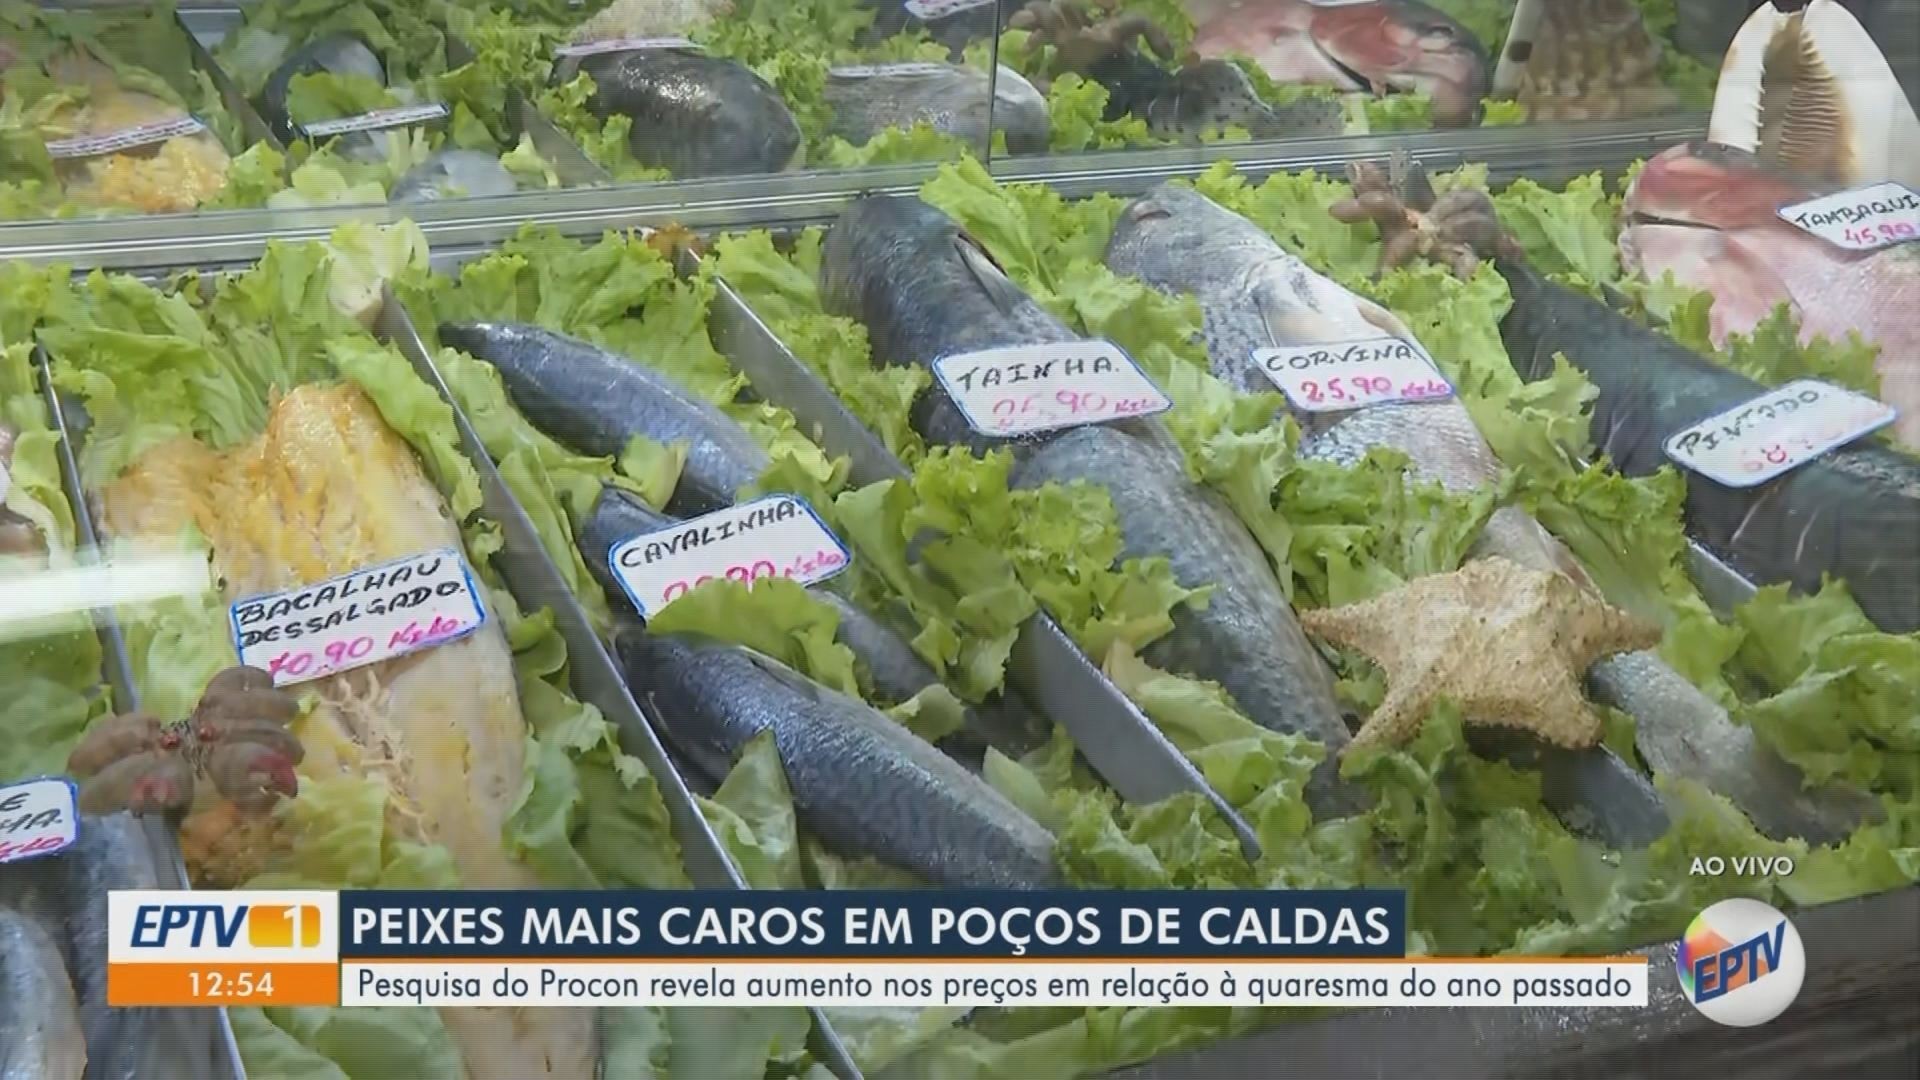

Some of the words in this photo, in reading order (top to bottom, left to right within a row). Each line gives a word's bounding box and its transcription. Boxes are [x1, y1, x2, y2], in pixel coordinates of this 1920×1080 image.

[1795, 195, 1920, 228] TAMBAQUI
[1300, 377, 1393, 403] 25,90
[237, 557, 441, 625] BACALHAU
